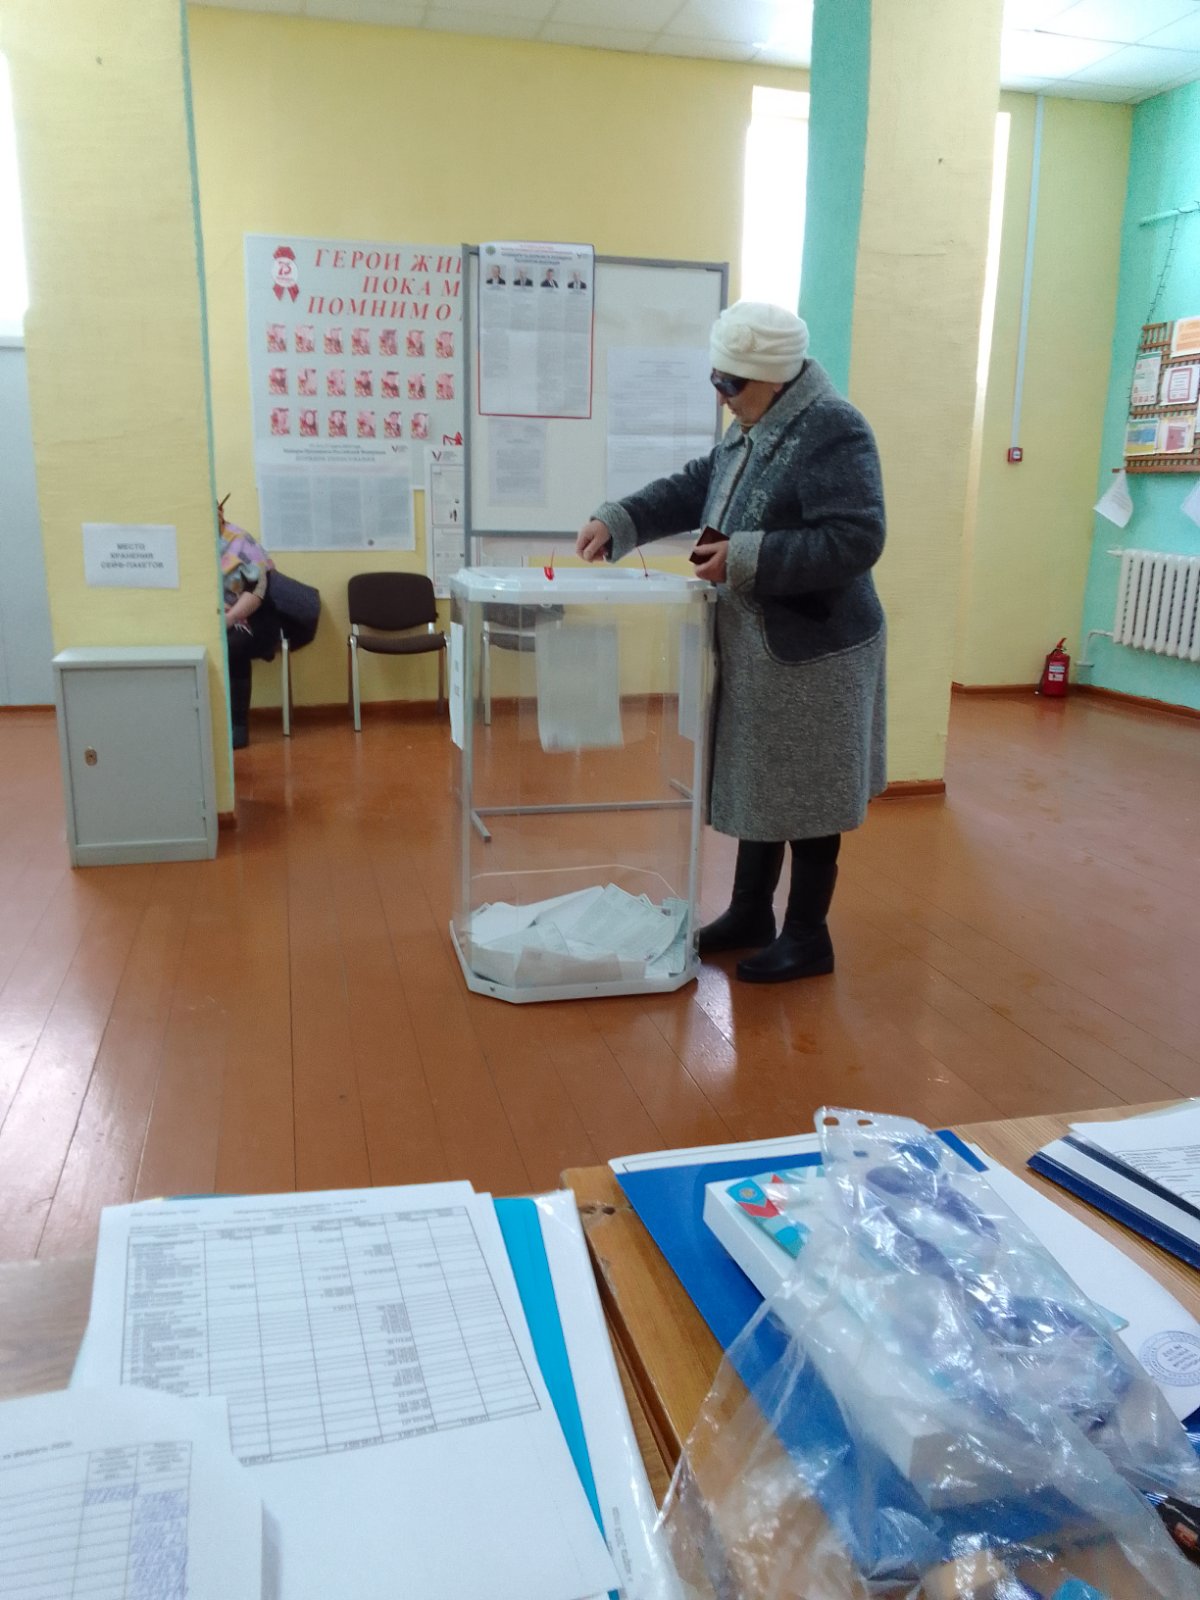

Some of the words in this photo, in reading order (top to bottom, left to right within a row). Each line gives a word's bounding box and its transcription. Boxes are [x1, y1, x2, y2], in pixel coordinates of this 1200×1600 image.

[315, 248, 400, 271] ГЕРОИ
[362, 275, 431, 296] ПОКА
[308, 295, 429, 320] ПОМНИМ
[117, 543, 145, 551] МЕСТО
